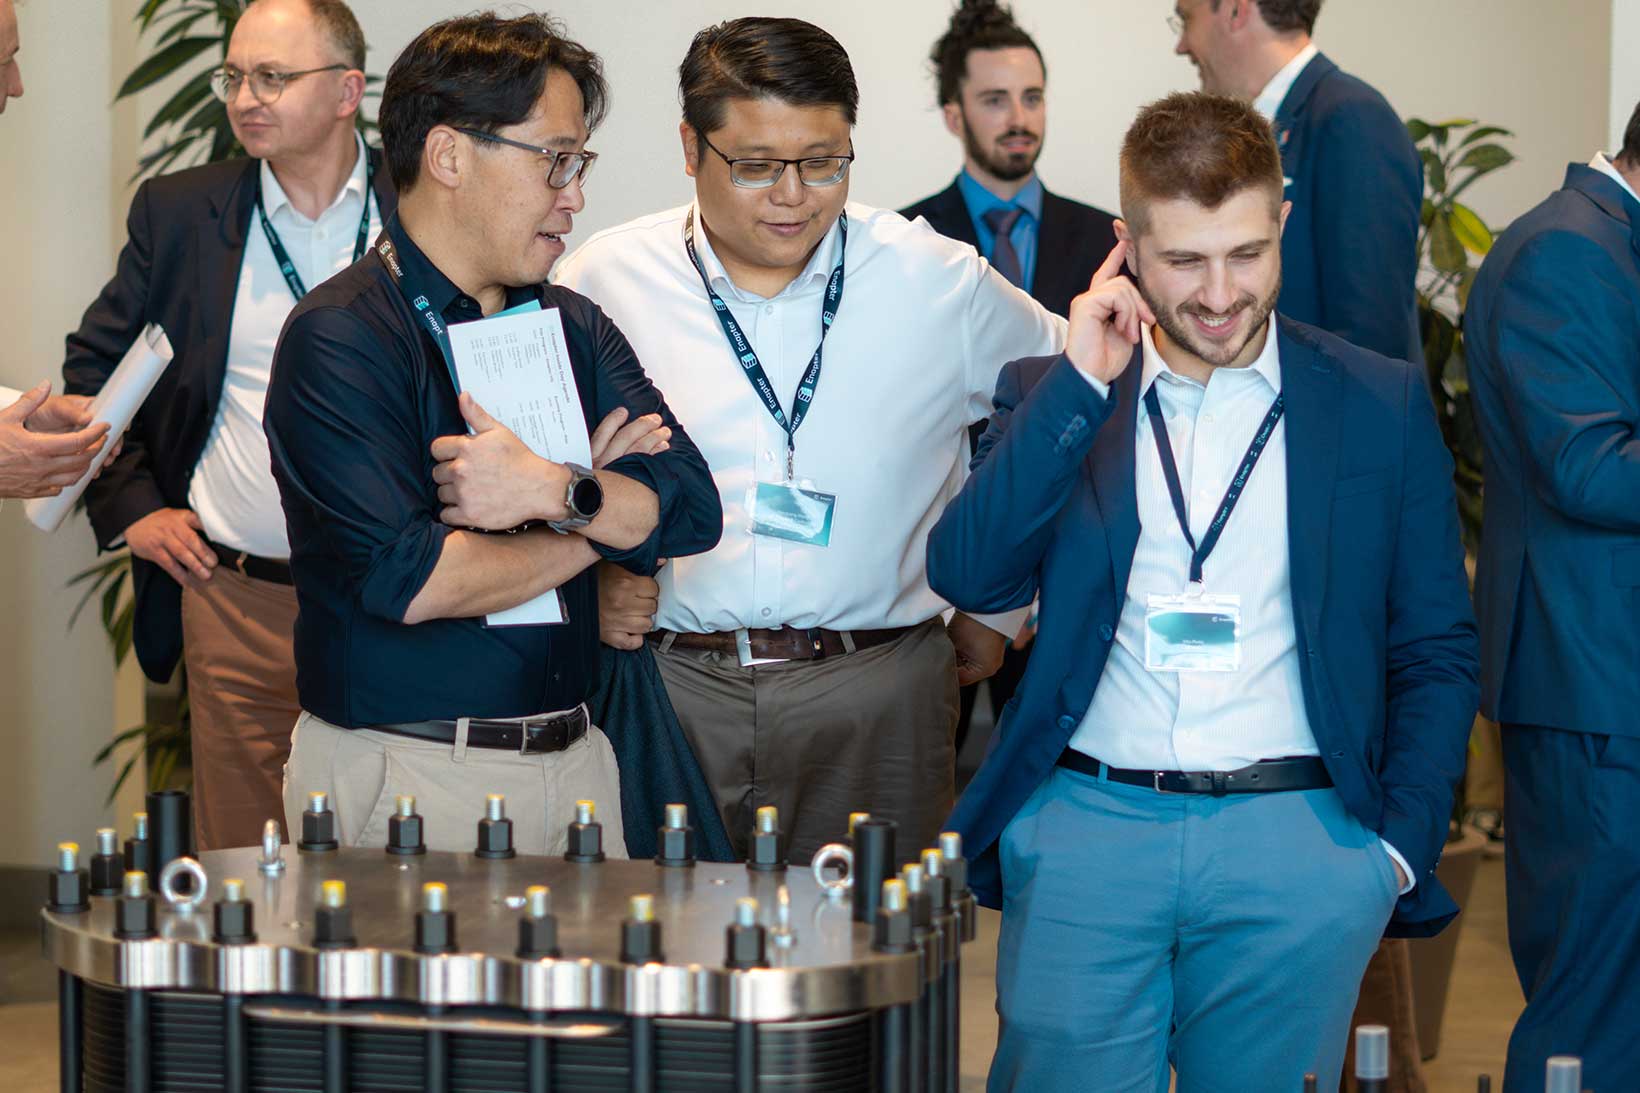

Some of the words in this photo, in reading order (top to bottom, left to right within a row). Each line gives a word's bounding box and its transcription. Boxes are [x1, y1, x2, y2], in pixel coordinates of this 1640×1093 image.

[386, 252, 404, 277] Enapter
[828, 269, 841, 301] Enapter
[425, 311, 443, 335] Enapt
[728, 320, 747, 352] Enapter
[805, 352, 820, 384] Enapter
[756, 377, 777, 409] Enapter
